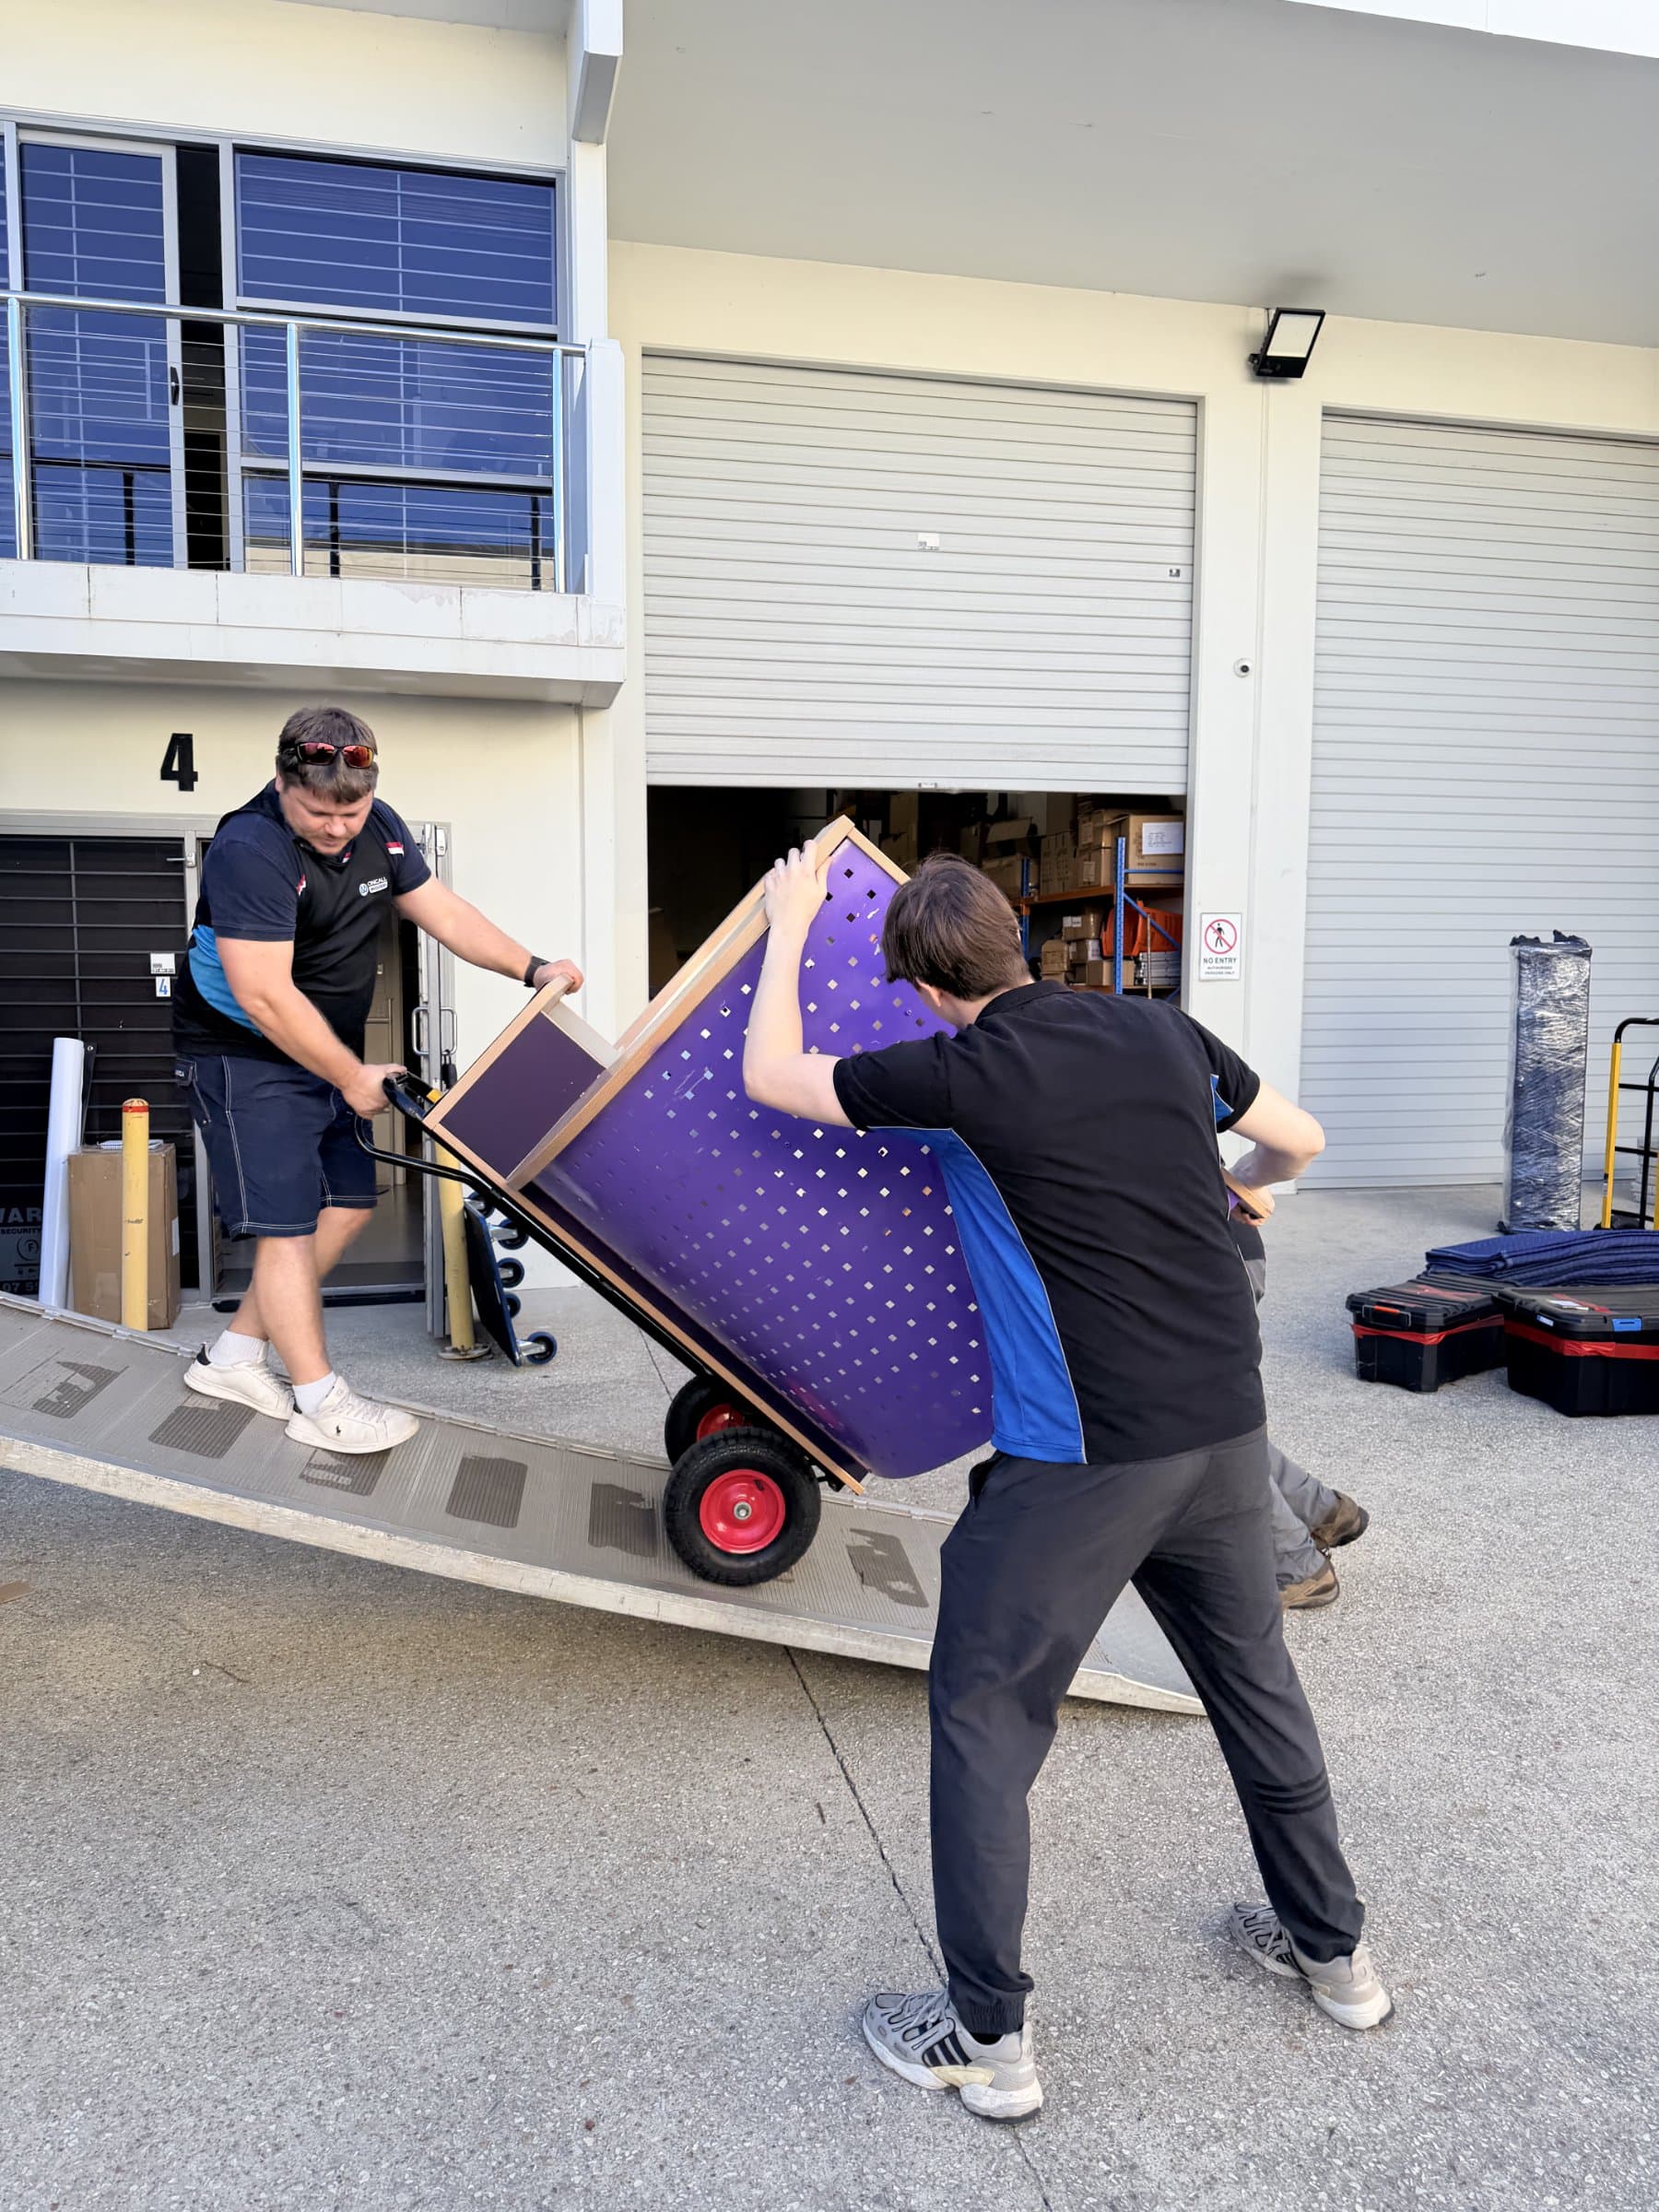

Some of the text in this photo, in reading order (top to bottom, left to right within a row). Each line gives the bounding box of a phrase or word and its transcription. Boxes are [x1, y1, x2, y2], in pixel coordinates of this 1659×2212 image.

[160, 733, 198, 792] 4
[159, 978, 168, 995] 4
[2, 1282, 20, 1292] 07
